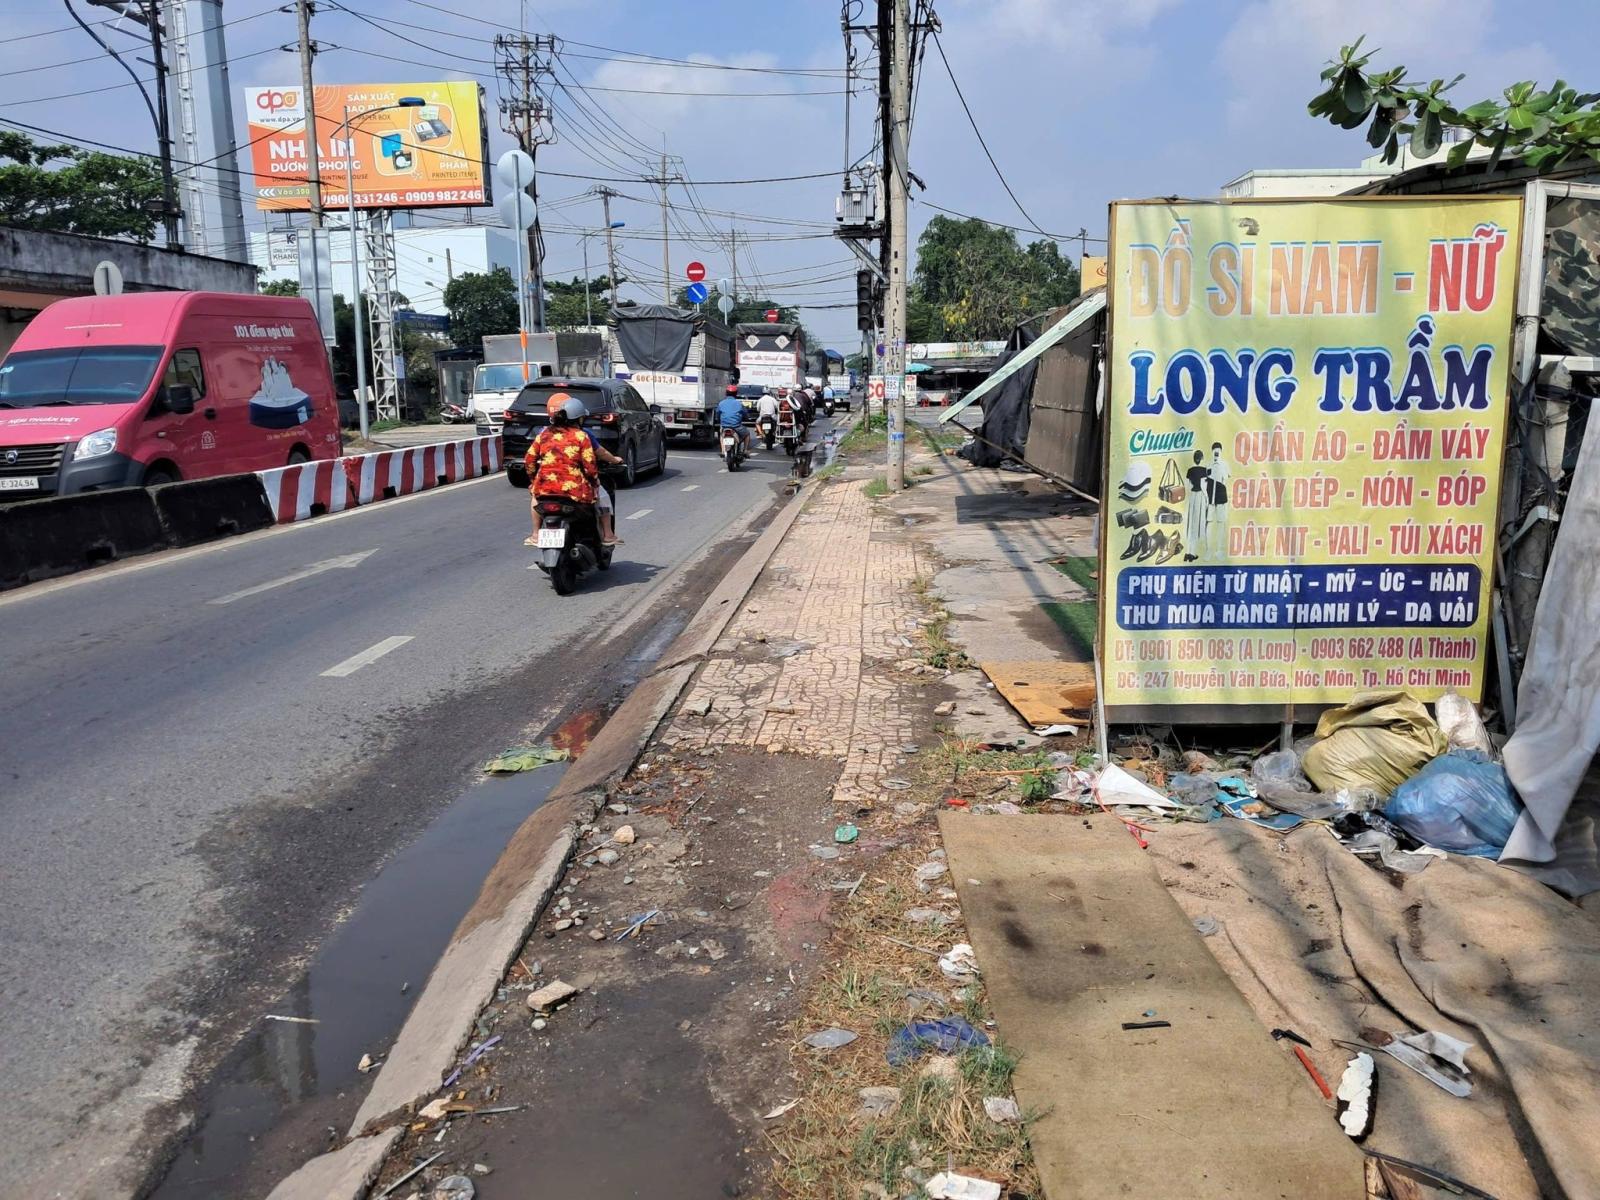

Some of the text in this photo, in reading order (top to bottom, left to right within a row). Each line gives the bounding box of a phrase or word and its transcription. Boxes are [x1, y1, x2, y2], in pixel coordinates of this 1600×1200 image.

[1206, 242, 1256, 316] SI
[1269, 240, 1382, 315] NAM
[1428, 221, 1508, 313] NỮ
[1128, 348, 1298, 414] LONG
[1129, 427, 1195, 455] Chuyên
[1234, 420, 1305, 466] QUẦN
[1312, 425, 1347, 462] ÁO
[1372, 419, 1433, 461] ĐẦM
[1441, 422, 1490, 459] VÁY
[1231, 472, 1287, 508] GIÀY
[1293, 472, 1339, 508] DÉP
[1362, 471, 1414, 506] NÓN
[1437, 469, 1486, 506] BÓP
[1229, 520, 1270, 556] DÂY
[1275, 527, 1309, 563] NỊT
[1328, 526, 1371, 556] VALI
[1390, 519, 1421, 555] TÚI
[1426, 518, 1483, 554] XÁCH
[1128, 574, 1166, 598] PHỤ
[1173, 571, 1217, 598] KIỆN
[1223, 570, 1248, 594] TỪ
[1253, 570, 1303, 597] NHẬT
[1326, 568, 1356, 593] MỸ
[1379, 568, 1406, 592] ÚC
[1429, 568, 1470, 592] HÀN
[1122, 605, 1160, 625] THU
[1167, 604, 1215, 624] MUA
[1222, 600, 1278, 624] HÀNG
[1285, 603, 1350, 624] THANH
[1356, 598, 1380, 622] LÝ
[1405, 602, 1432, 622] DA
[1439, 596, 1474, 622] VẢI
[1139, 639, 1172, 661] 0901
[1177, 639, 1203, 660] 850
[1208, 638, 1234, 660] 083
[1257, 638, 1297, 663] Long)
[1311, 638, 1344, 660] 0903
[1349, 637, 1374, 660] 662
[1378, 637, 1404, 659] 488
[1408, 637, 1424, 661] (A
[1428, 636, 1477, 661] Thành)
[1144, 671, 1169, 688] 247
[1173, 668, 1225, 689] Nguyễn
[1230, 670, 1255, 688] Văn
[1295, 669, 1320, 687] Hóc
[1324, 669, 1357, 688] Môn,
[1362, 669, 1381, 688] Tp.
[1385, 666, 1404, 686] Hồ
[1408, 668, 1431, 686] Chí
[1435, 669, 1471, 686] Minh
